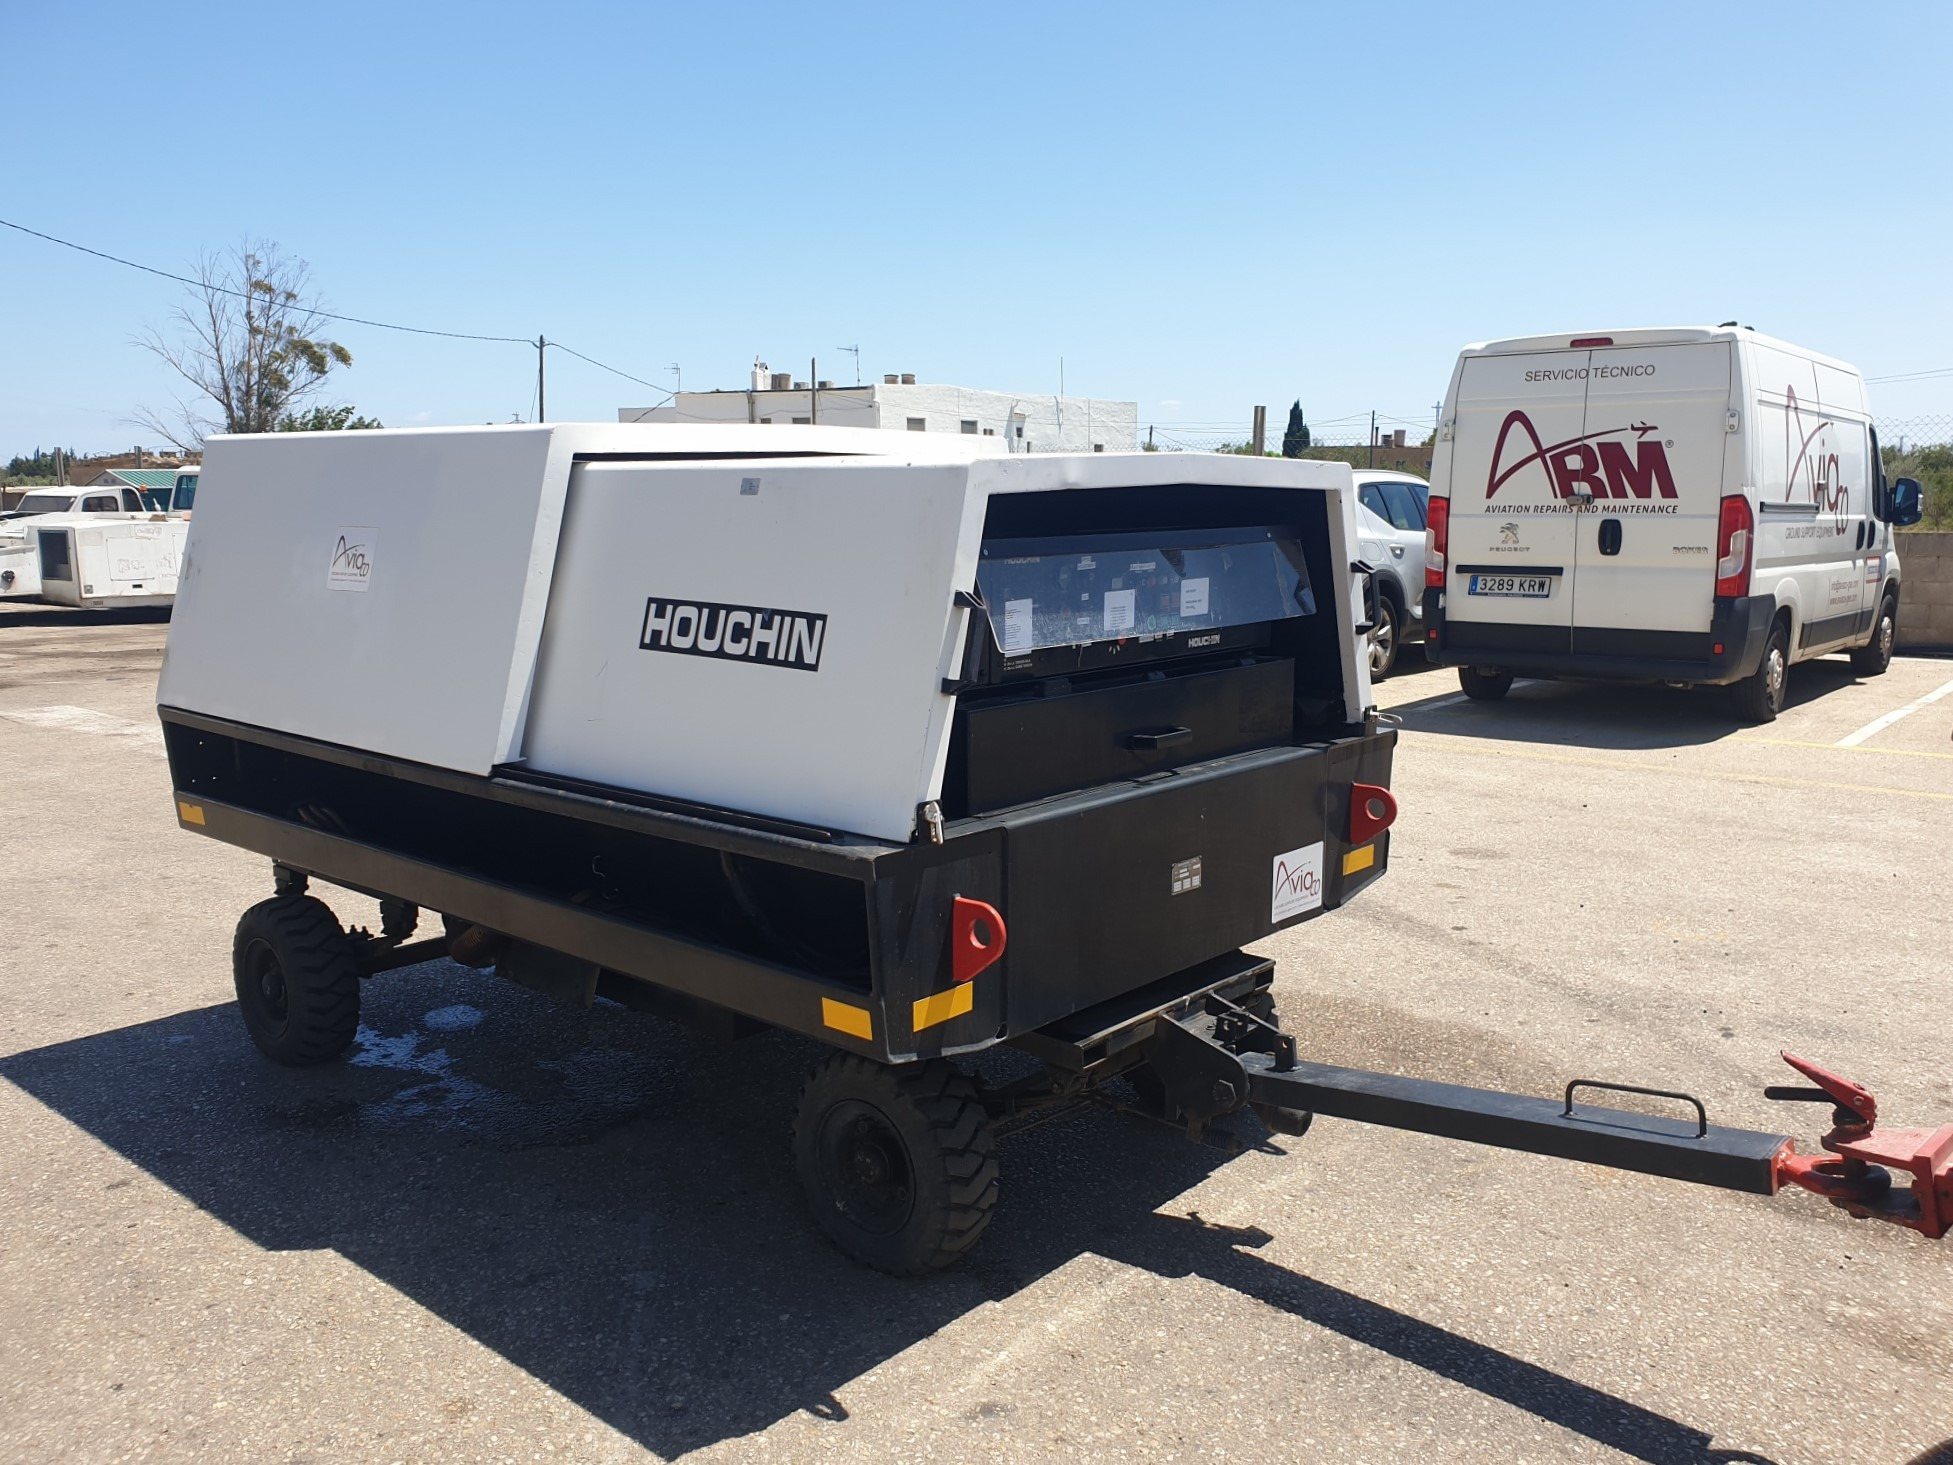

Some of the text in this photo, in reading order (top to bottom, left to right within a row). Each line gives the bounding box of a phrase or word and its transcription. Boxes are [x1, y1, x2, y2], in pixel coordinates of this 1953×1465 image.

[1524, 364, 1656, 382] SERVICIO TÉCNICO
[1485, 505, 1679, 514] AVIATION REPAIRS AND MAINTENANCE
[1479, 578, 1547, 593] 3289 KRW
[643, 603, 824, 665] HOUCHIN
[1188, 635, 1220, 648] HOUCHIN
